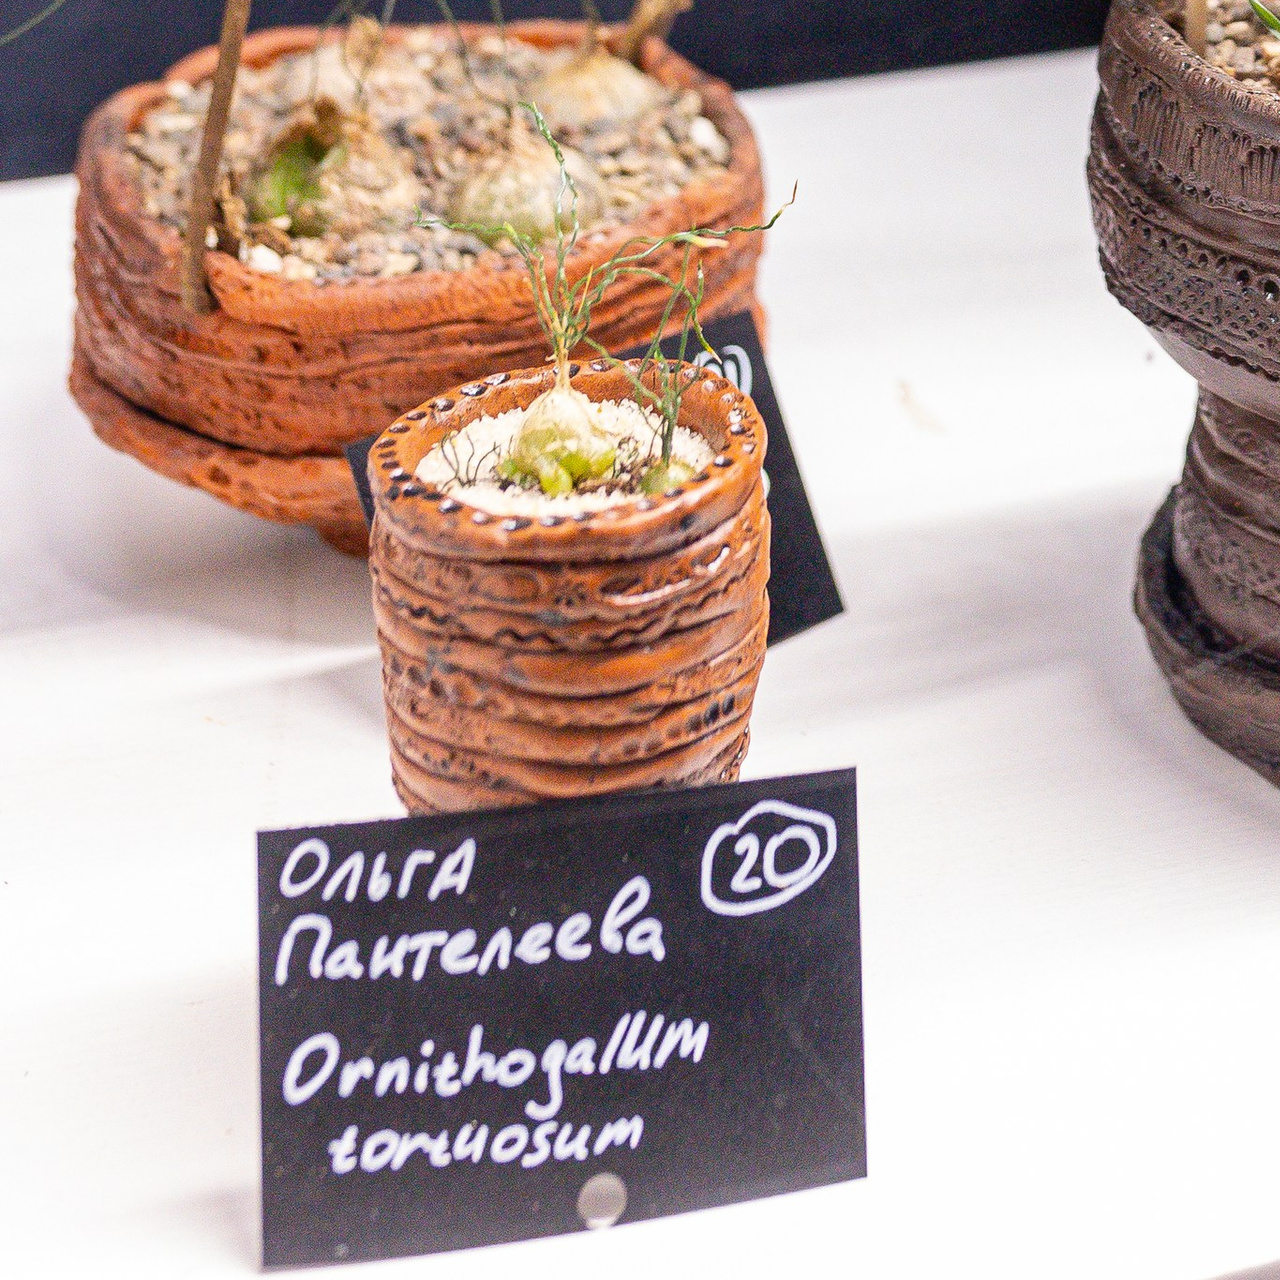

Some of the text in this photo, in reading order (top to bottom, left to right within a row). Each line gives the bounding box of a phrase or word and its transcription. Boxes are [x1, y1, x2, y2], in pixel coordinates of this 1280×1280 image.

[730, 825, 821, 894] 20
[274, 876, 666, 986] Пантелеева
[328, 1115, 644, 1174] tortuosum
